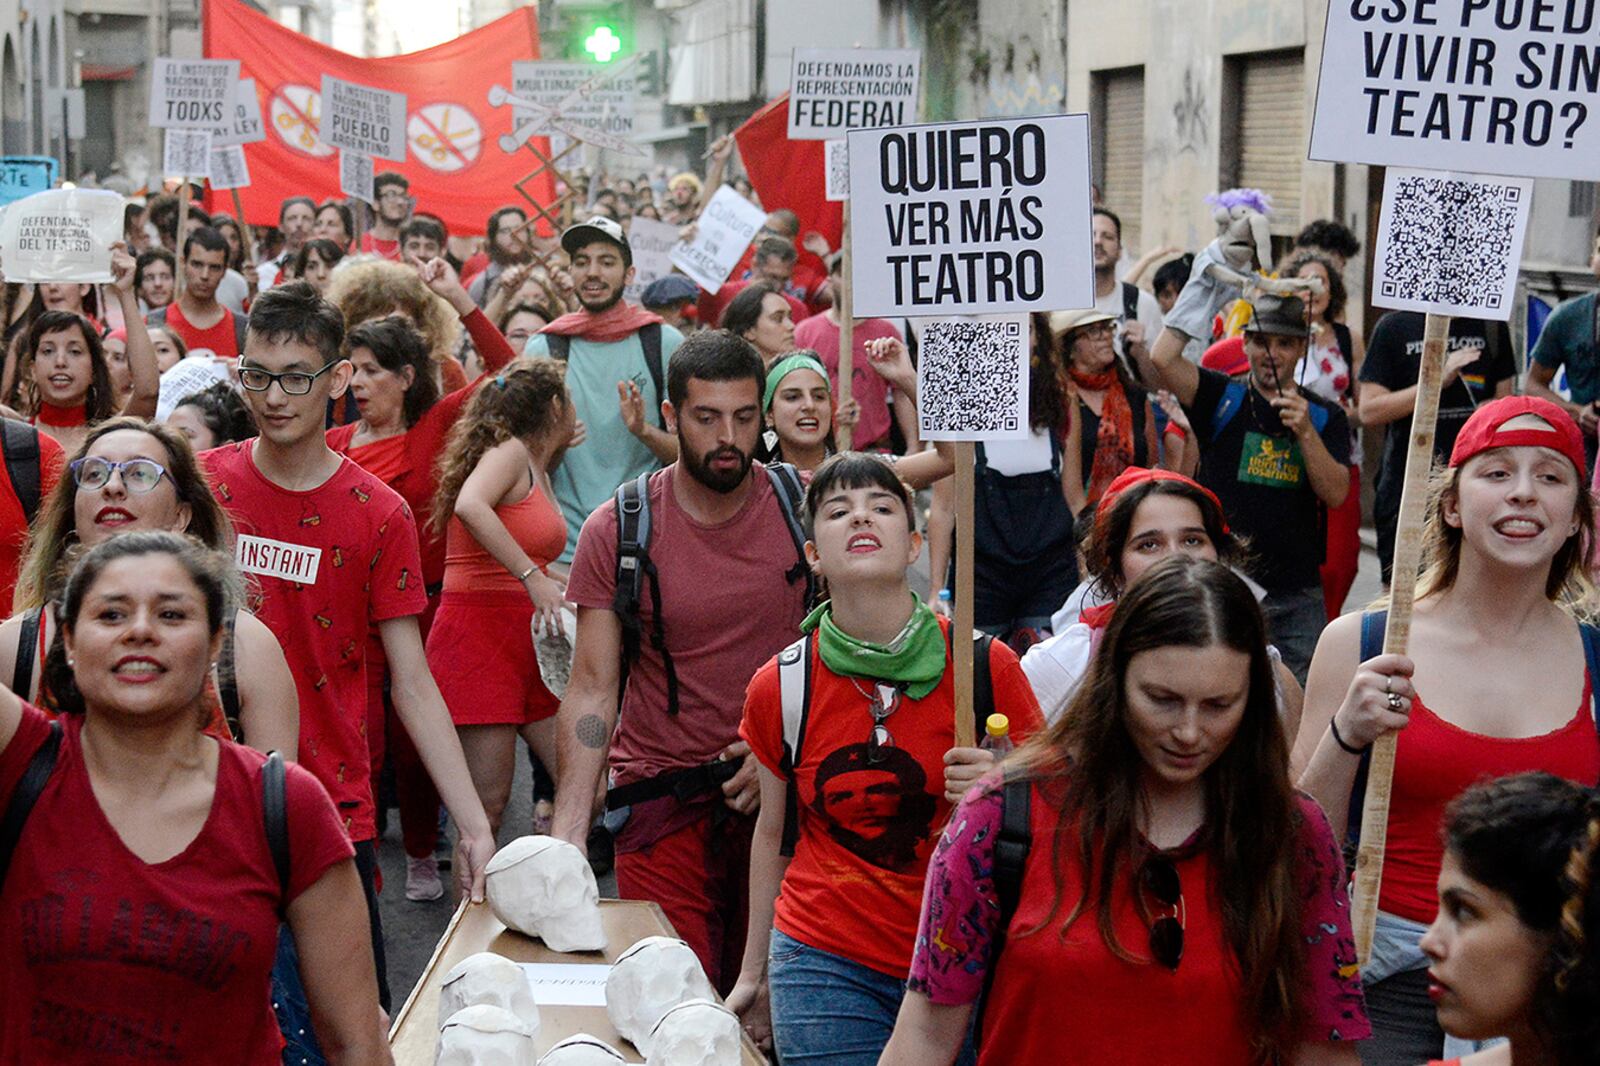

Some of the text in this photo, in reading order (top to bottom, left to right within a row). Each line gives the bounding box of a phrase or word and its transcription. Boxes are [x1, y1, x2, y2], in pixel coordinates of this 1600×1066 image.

[1460, 0, 1600, 35] PUED
[165, 63, 177, 76] EL
[797, 61, 914, 78] DEFENDAMOS LA
[1363, 31, 1600, 94] VIVIR SIN
[796, 79, 913, 96] REPRESENTACIÓN
[165, 101, 224, 121] TODXS
[1363, 87, 1588, 149] TEATRO?
[233, 119, 258, 135] LEY
[332, 113, 390, 143] PUEBLO
[879, 123, 1046, 196] QUIERO
[885, 187, 1044, 246] VER MÁS
[19, 238, 41, 251] DEL
[630, 233, 674, 252] Cultur
[886, 249, 1044, 306] TEATRO
[241, 540, 316, 578] INSTANT
